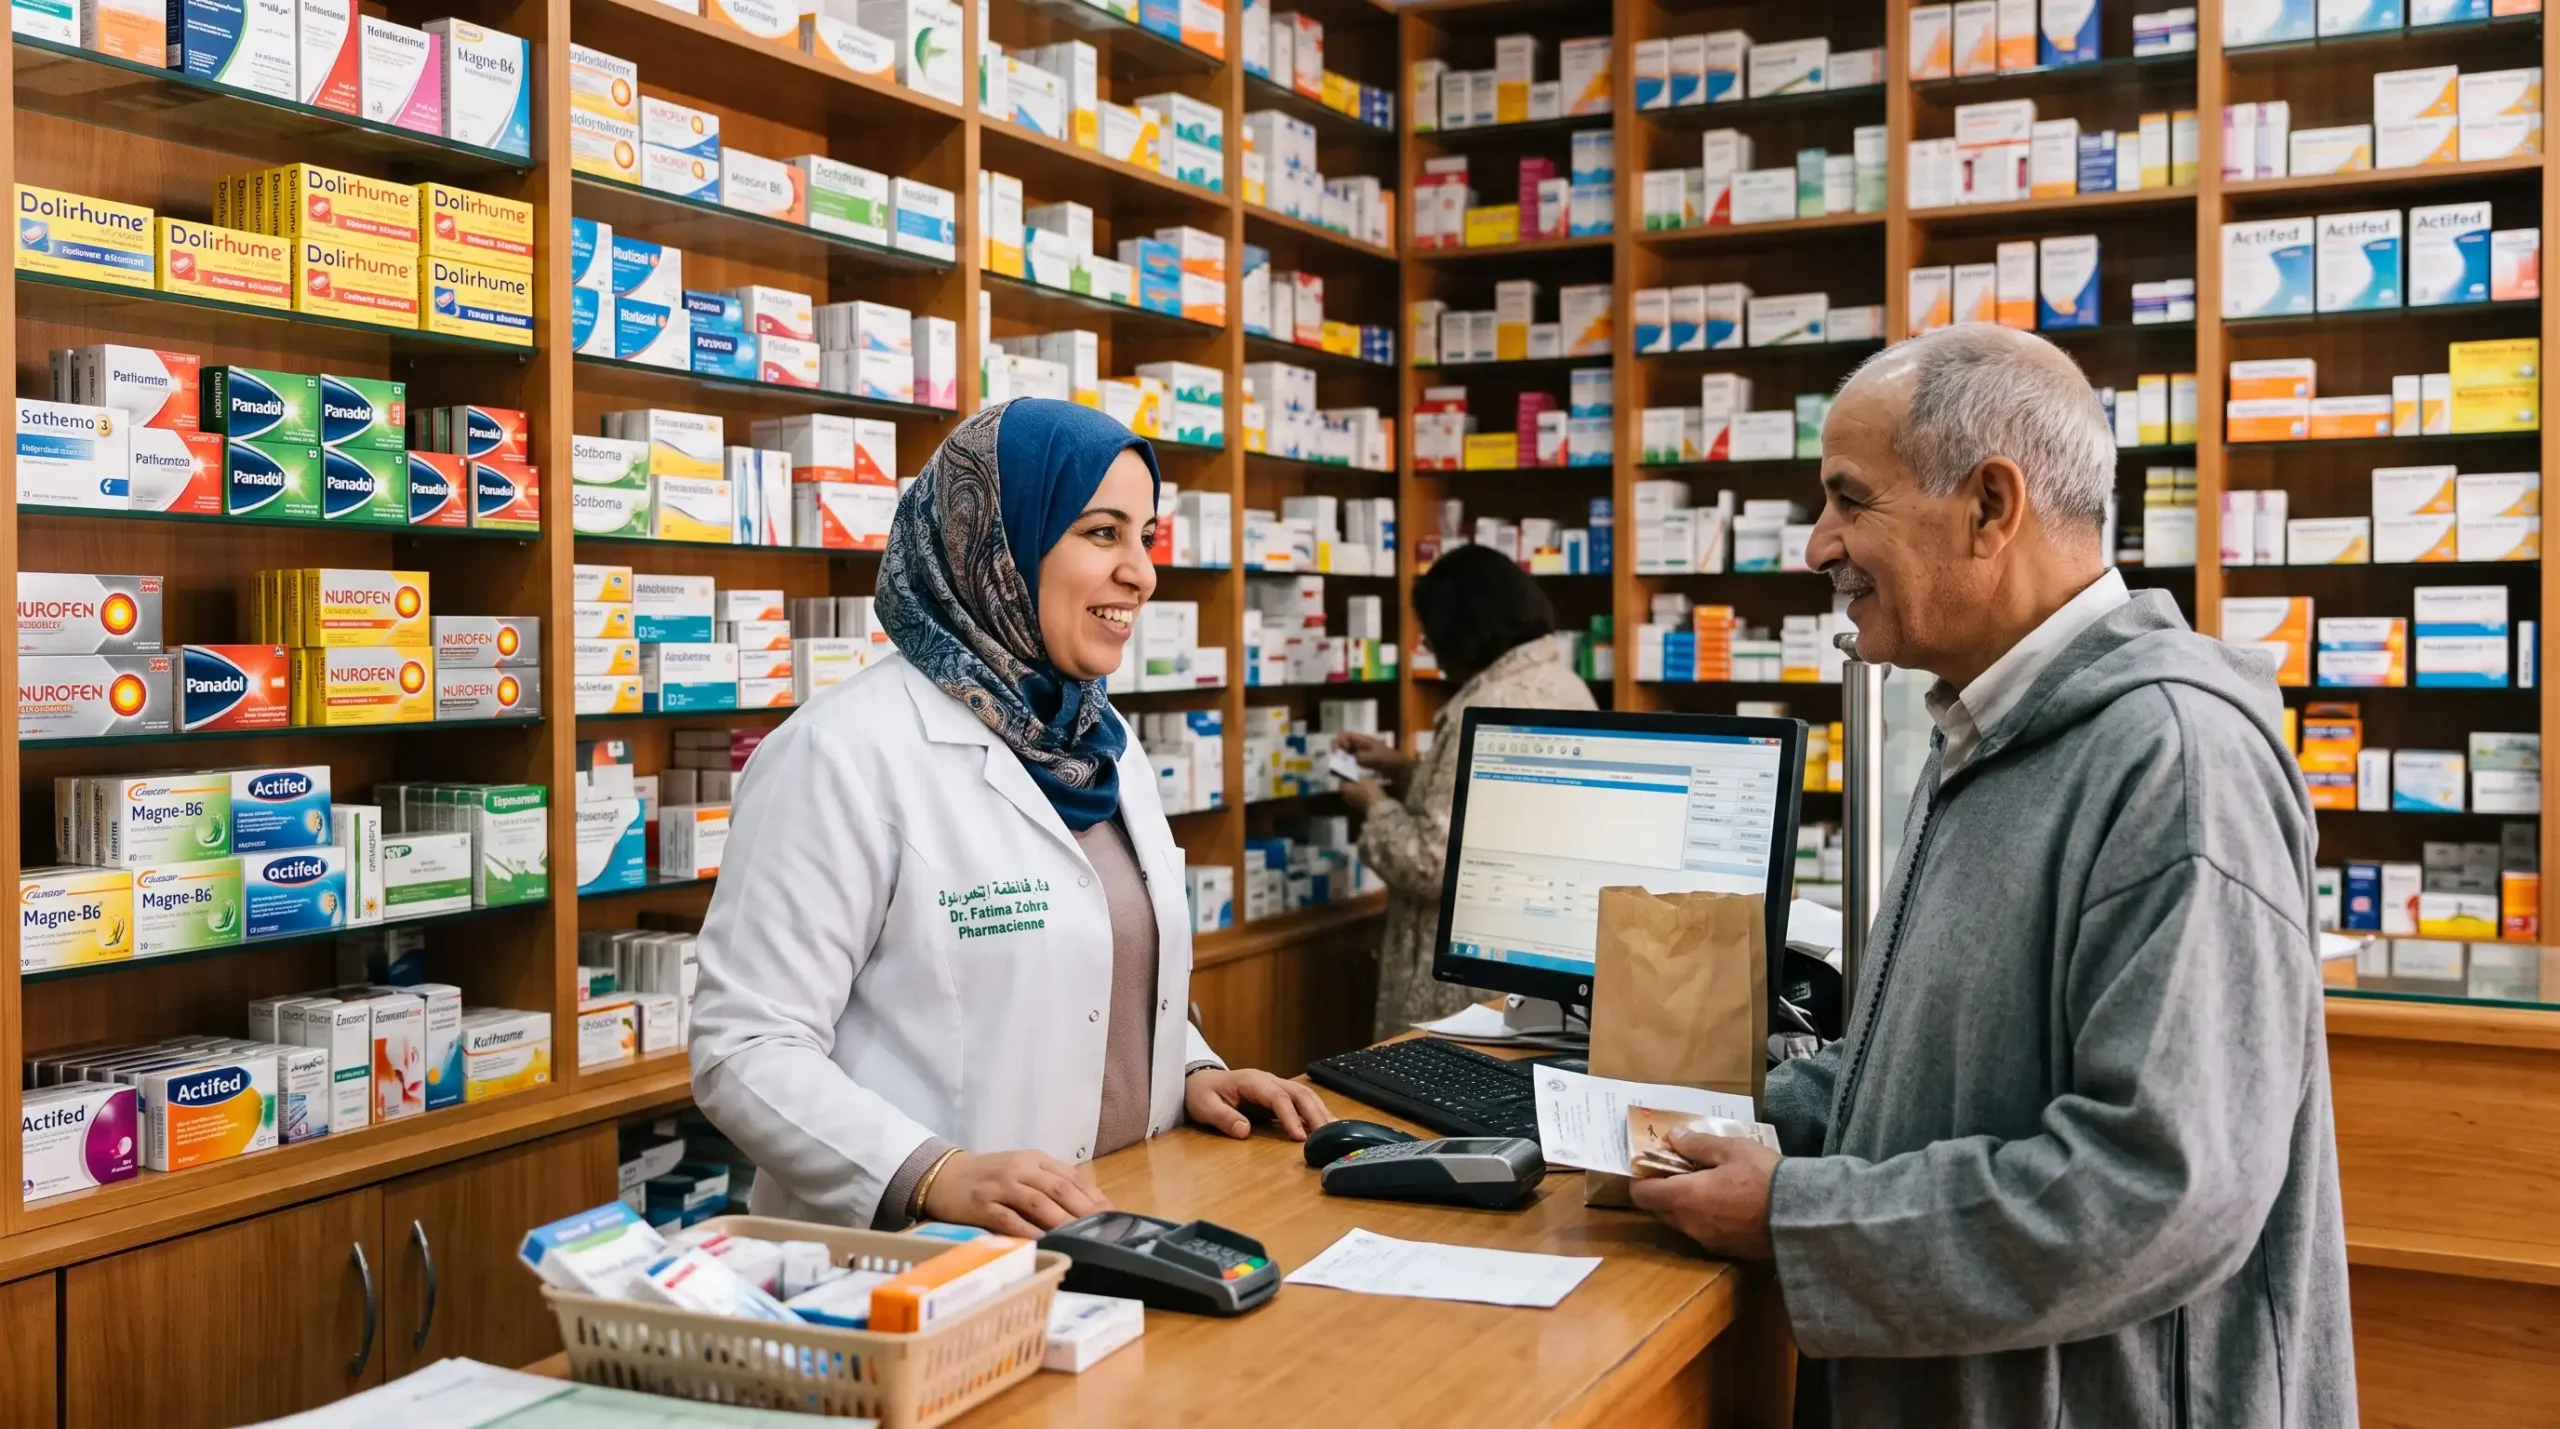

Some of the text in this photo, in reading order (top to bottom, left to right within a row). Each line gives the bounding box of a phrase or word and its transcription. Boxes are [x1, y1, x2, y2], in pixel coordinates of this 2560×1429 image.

[458, 47, 515, 75] Magne-B6
[309, 170, 410, 207] Dolirhume
[20, 191, 144, 232] Dolirhume
[434, 189, 526, 224] Dolirhume
[2325, 219, 2390, 238] Actifed
[2416, 211, 2482, 229] Actifed
[170, 224, 282, 261] Dolirhume
[2231, 227, 2300, 246] Actifed
[307, 244, 409, 279] Dolirhume
[434, 262, 525, 295] Dolirhume
[101, 419, 108, 431] 3
[327, 476, 372, 492] Panadol
[325, 589, 391, 605] NUROFEN
[442, 633, 492, 645] NUROFEN
[330, 666, 396, 683] NUROFEN
[19, 684, 103, 702] NUROFEN
[186, 676, 244, 694] Panadol
[443, 684, 493, 697] NUROFEN
[253, 777, 306, 796] Actifed
[132, 801, 203, 823] Magne-B6
[268, 860, 322, 880] actifed
[142, 887, 212, 910] Magne-B6
[24, 904, 102, 928] Magne-B6
[950, 900, 1049, 923] Dr. Fatima Zohra
[958, 919, 1045, 939] Pharmacienne
[177, 1072, 241, 1102] Actifed
[22, 1105, 85, 1133] Actifed
